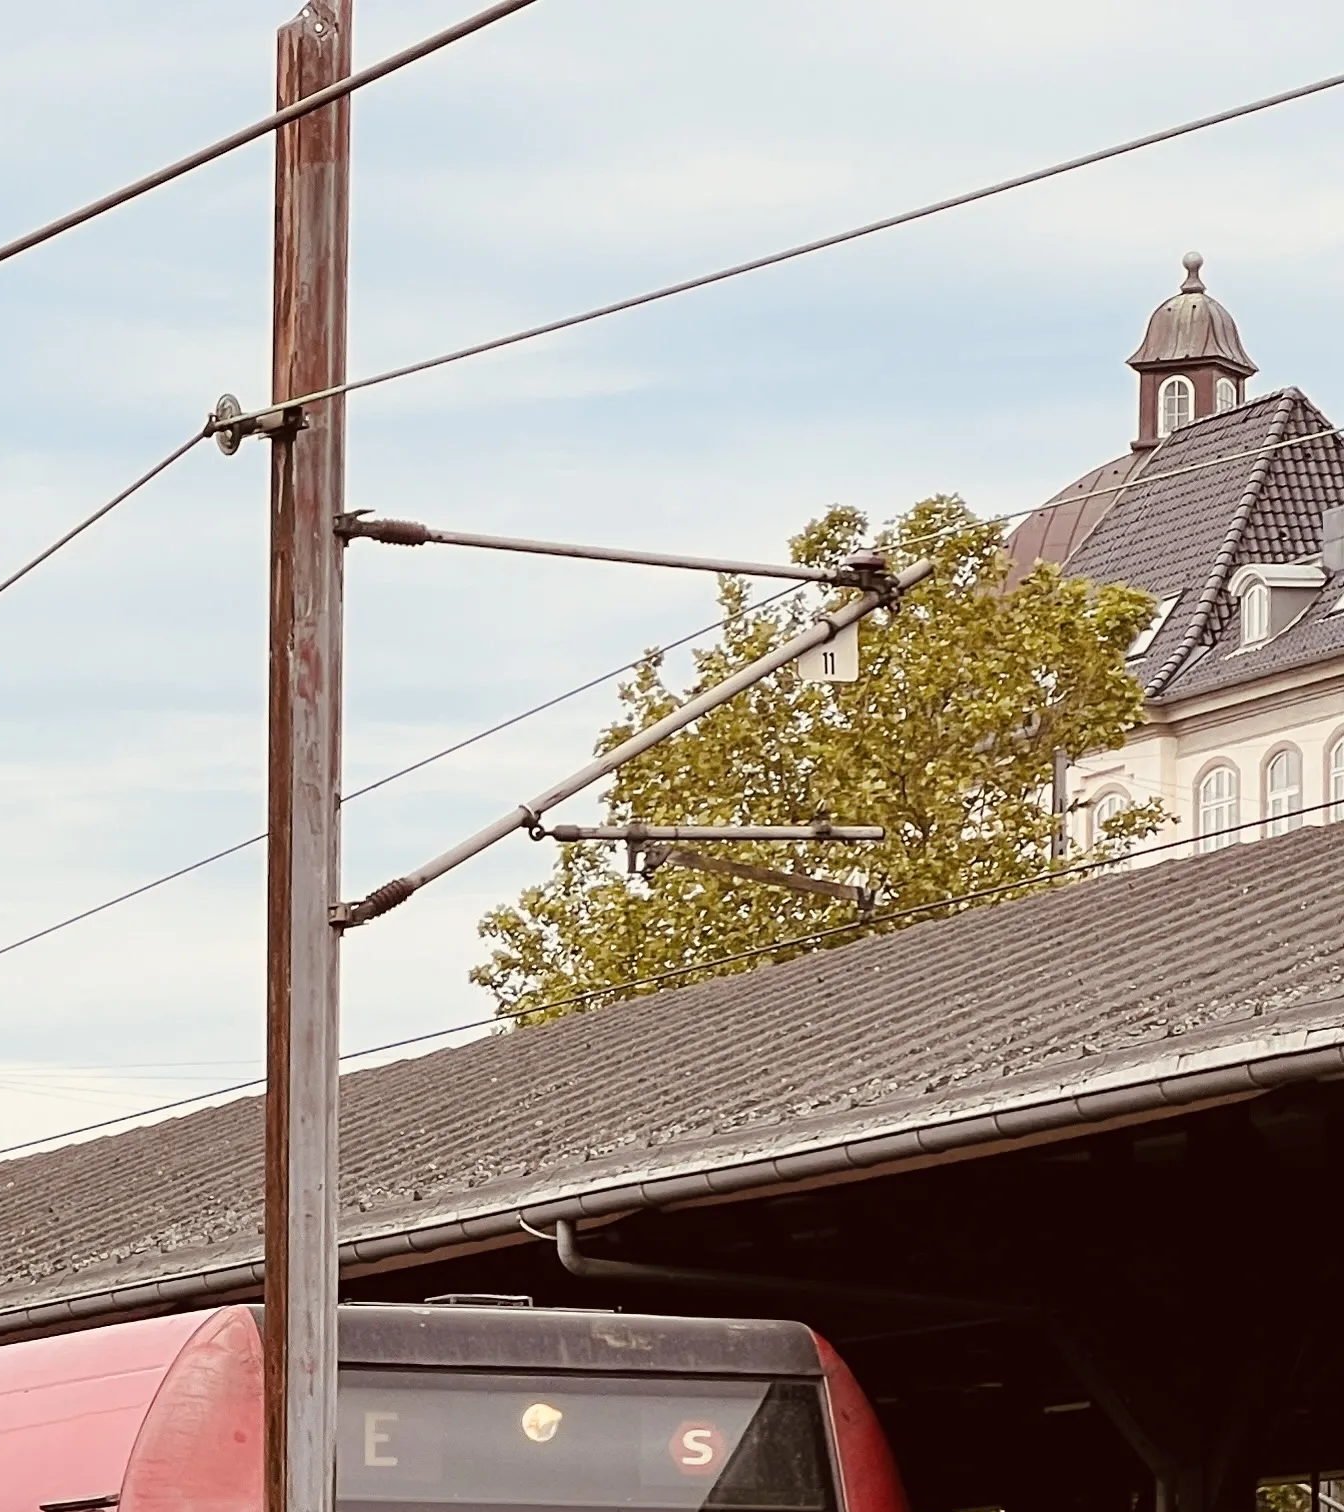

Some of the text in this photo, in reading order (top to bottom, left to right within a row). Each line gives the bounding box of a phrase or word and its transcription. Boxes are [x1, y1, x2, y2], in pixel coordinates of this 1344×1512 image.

[822, 652, 835, 675] 11
[364, 1412, 399, 1467] E
[681, 1429, 713, 1465] S
